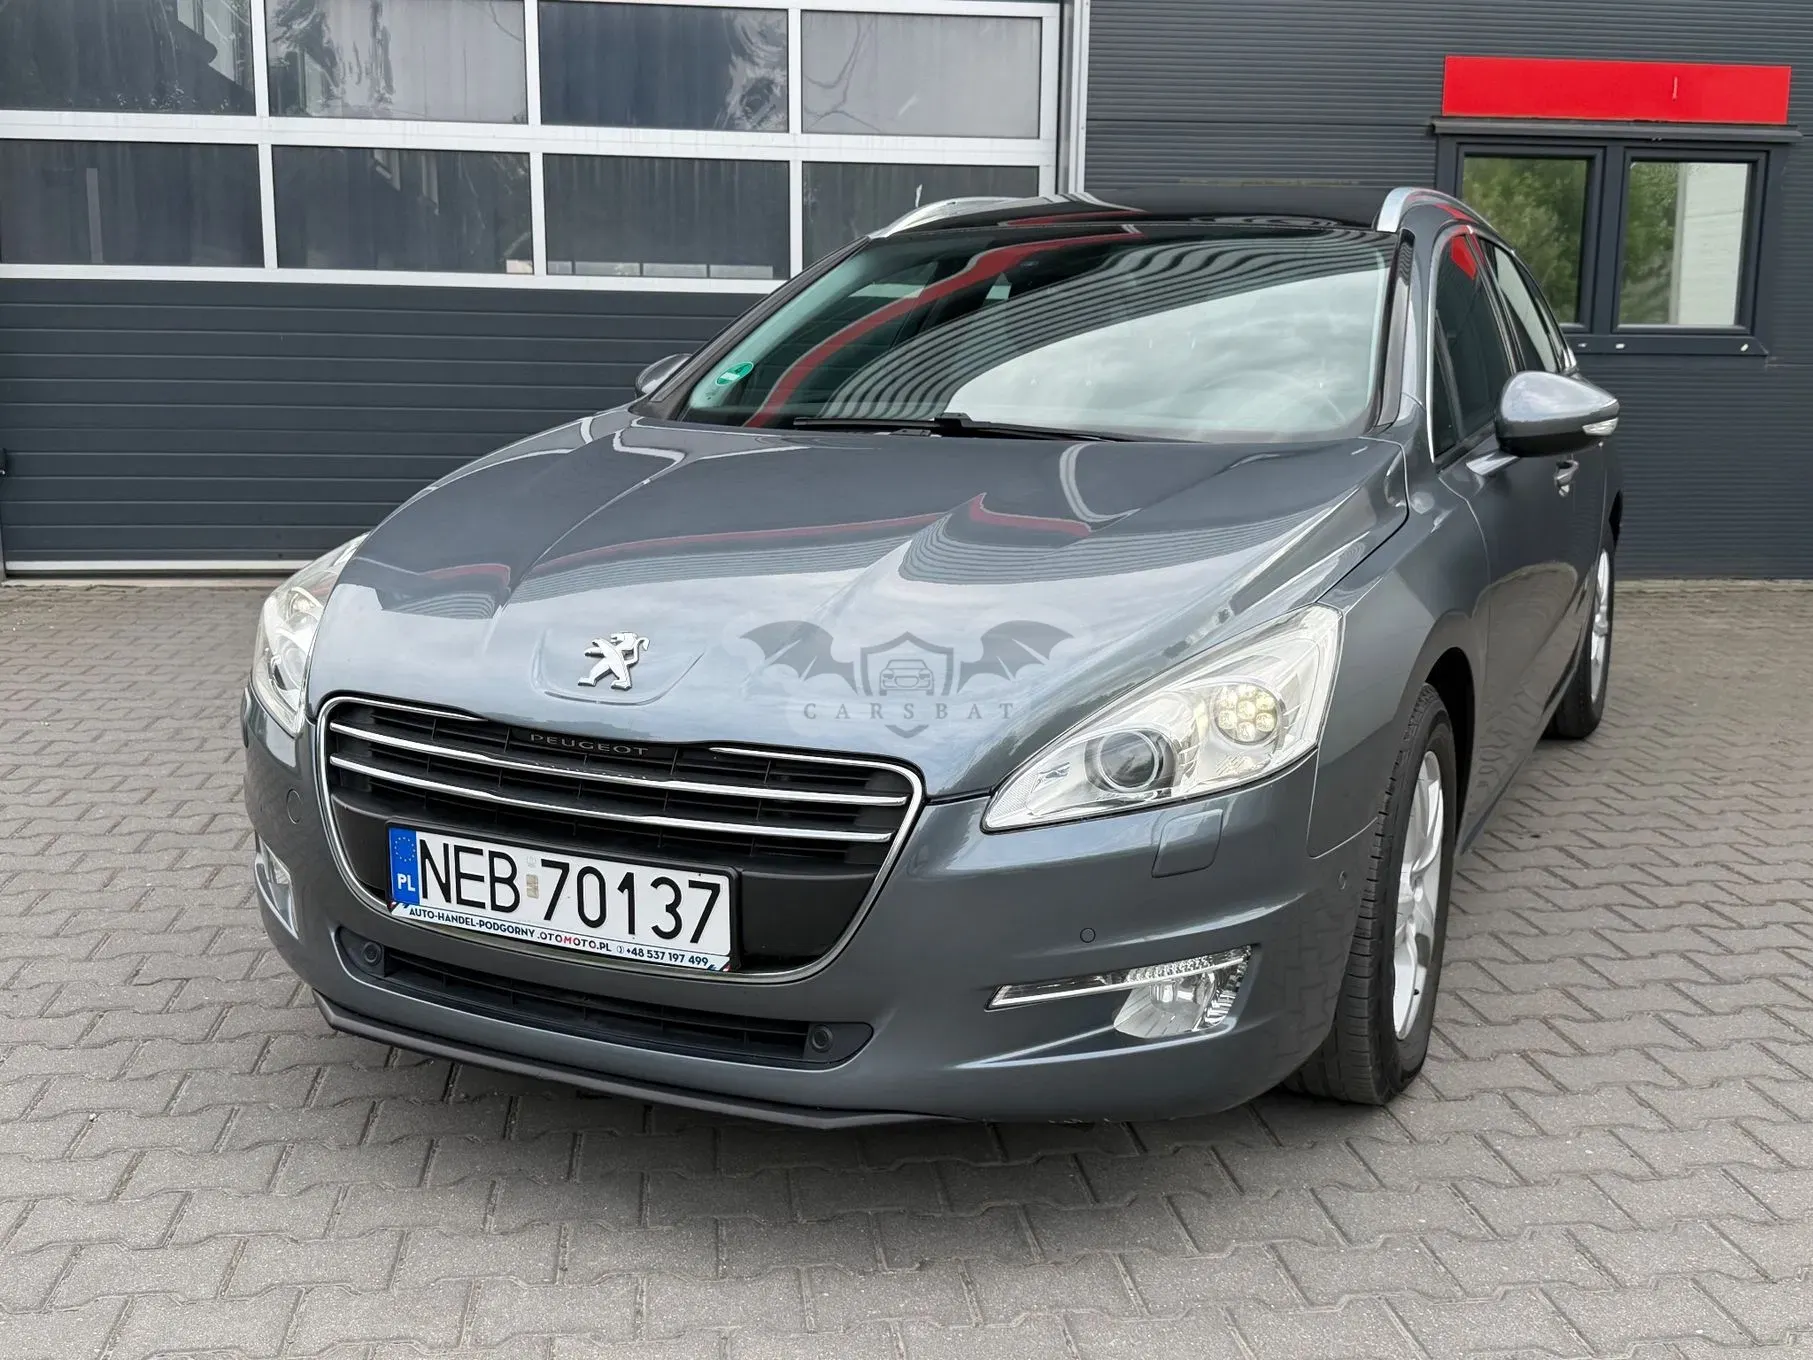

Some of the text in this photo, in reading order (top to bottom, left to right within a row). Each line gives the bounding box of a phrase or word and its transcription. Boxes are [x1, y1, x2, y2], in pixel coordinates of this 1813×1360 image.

[530, 733, 649, 756] PEUGEOT
[397, 873, 416, 892] PL
[419, 838, 721, 944] NEB 70137
[626, 946, 645, 958] +48
[646, 950, 665, 961] 537
[668, 952, 685, 963] 197
[688, 955, 709, 967] 499
